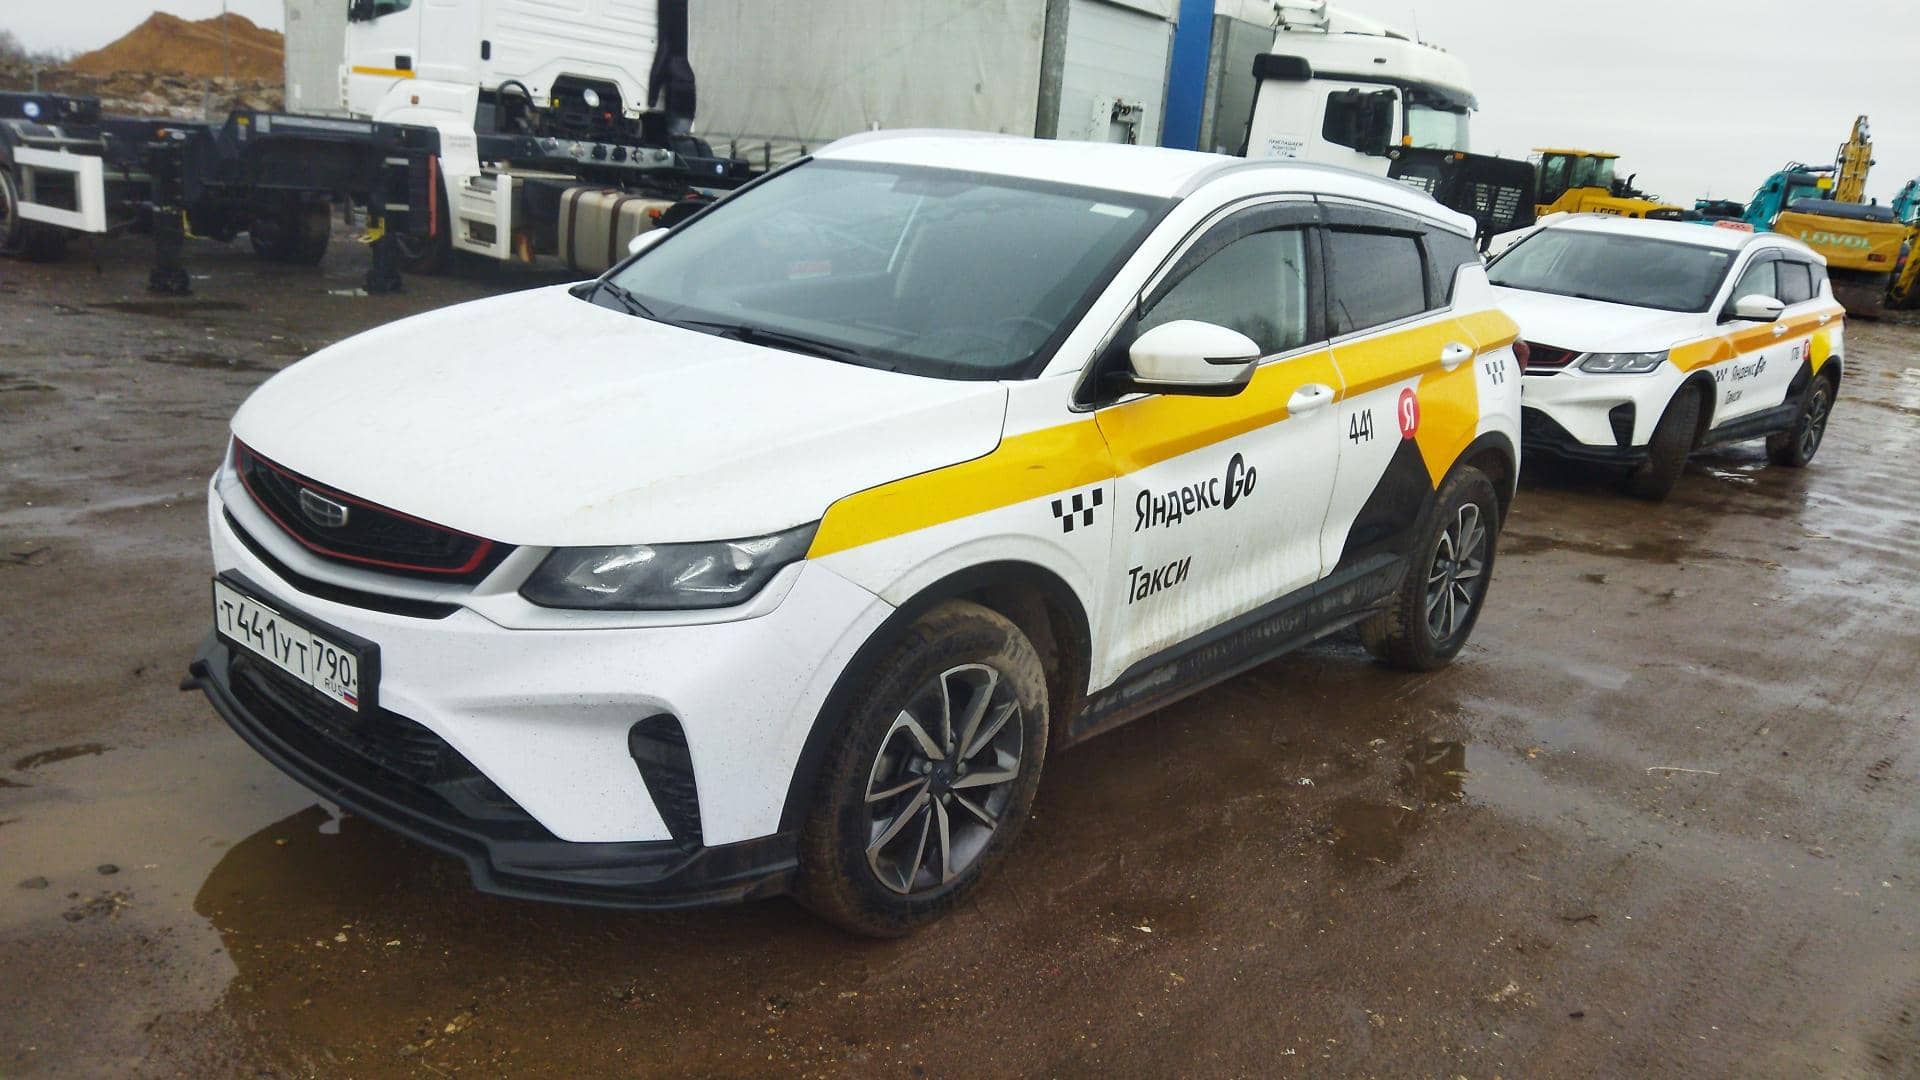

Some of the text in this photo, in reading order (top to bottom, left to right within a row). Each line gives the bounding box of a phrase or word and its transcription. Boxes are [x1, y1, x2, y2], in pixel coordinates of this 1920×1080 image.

[1799, 229, 1872, 251] LOVOL
[1349, 408, 1374, 444] 441
[1403, 396, 1415, 432] Я
[1134, 452, 1257, 532] Яндекс Go
[1128, 556, 1191, 605] Такси
[324, 679, 343, 697] RUS
